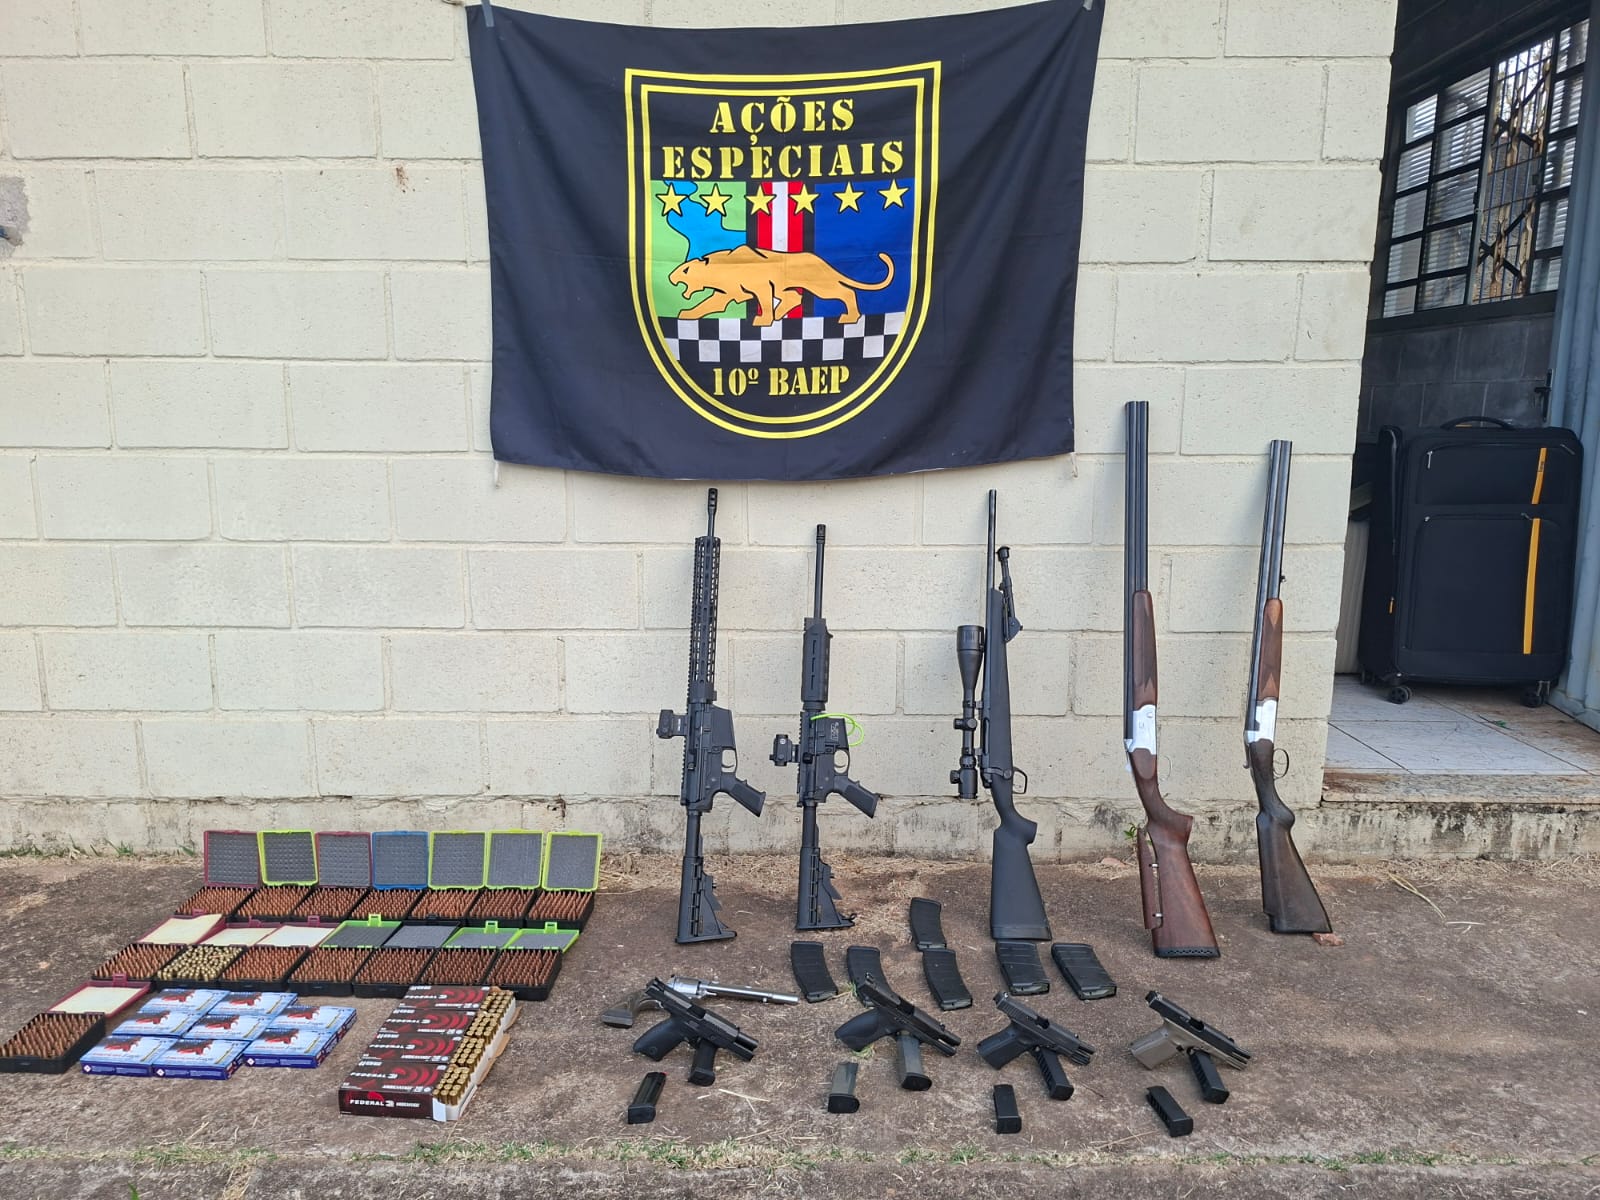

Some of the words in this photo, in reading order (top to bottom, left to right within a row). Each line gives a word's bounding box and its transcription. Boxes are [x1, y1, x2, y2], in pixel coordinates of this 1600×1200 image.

[709, 97, 854, 145] AÇÕES
[662, 141, 904, 179] ESPECIAIS
[768, 365, 850, 396] BAEP
